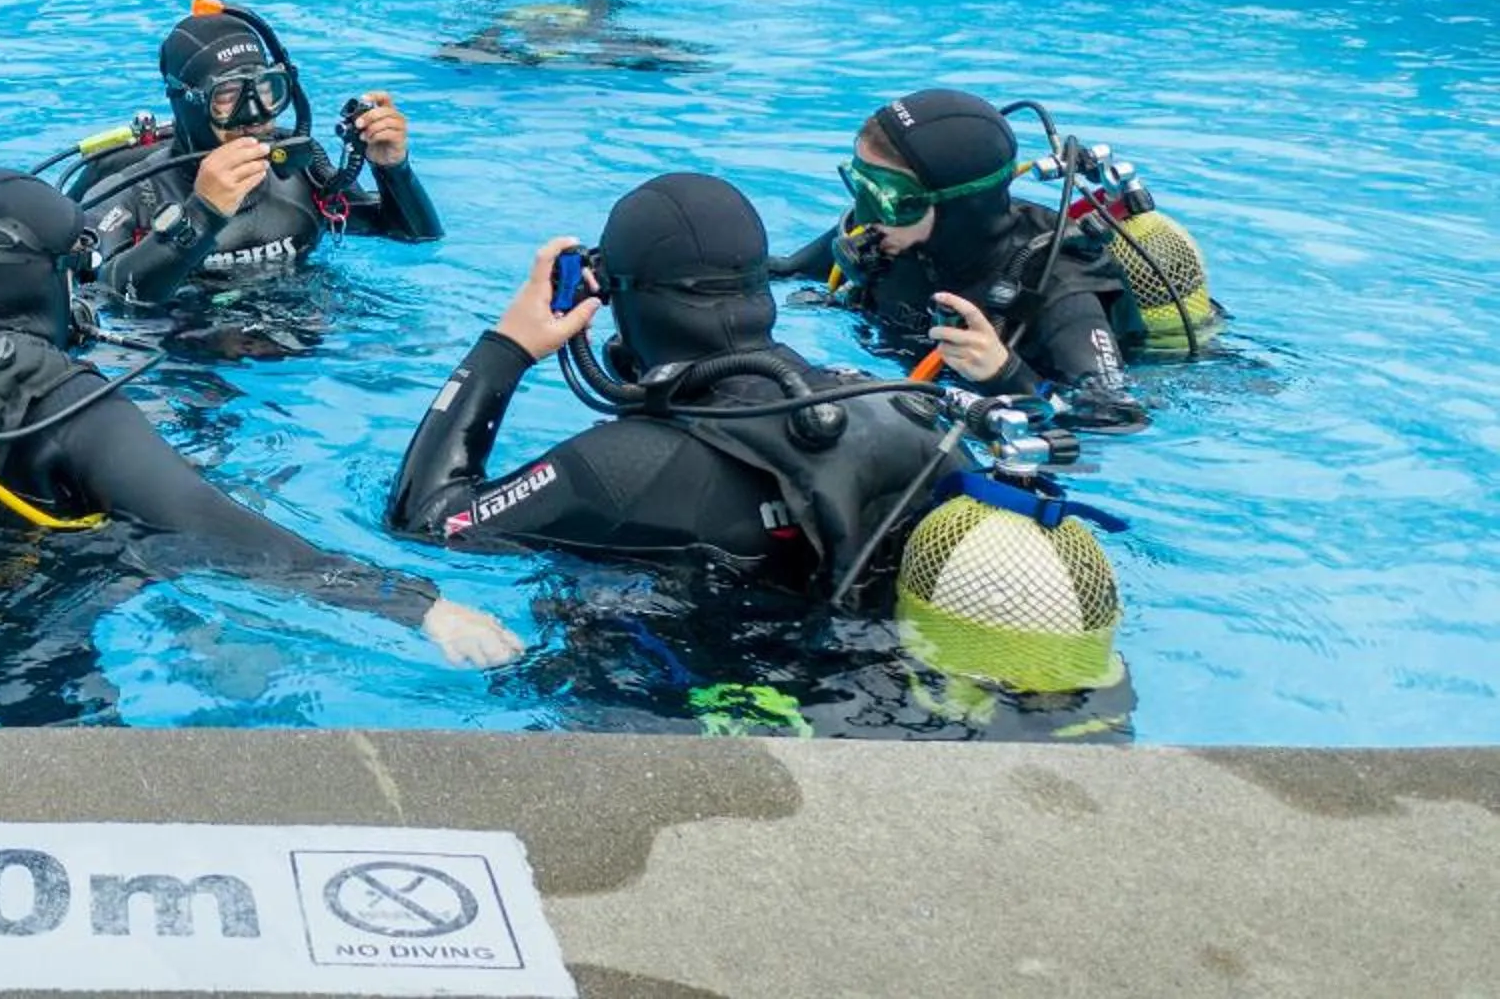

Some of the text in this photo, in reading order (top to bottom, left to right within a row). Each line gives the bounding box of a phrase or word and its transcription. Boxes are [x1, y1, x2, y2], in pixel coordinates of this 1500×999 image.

[203, 236, 296, 269] mares
[478, 463, 557, 522] mares
[336, 944, 495, 960] NO DIVING
